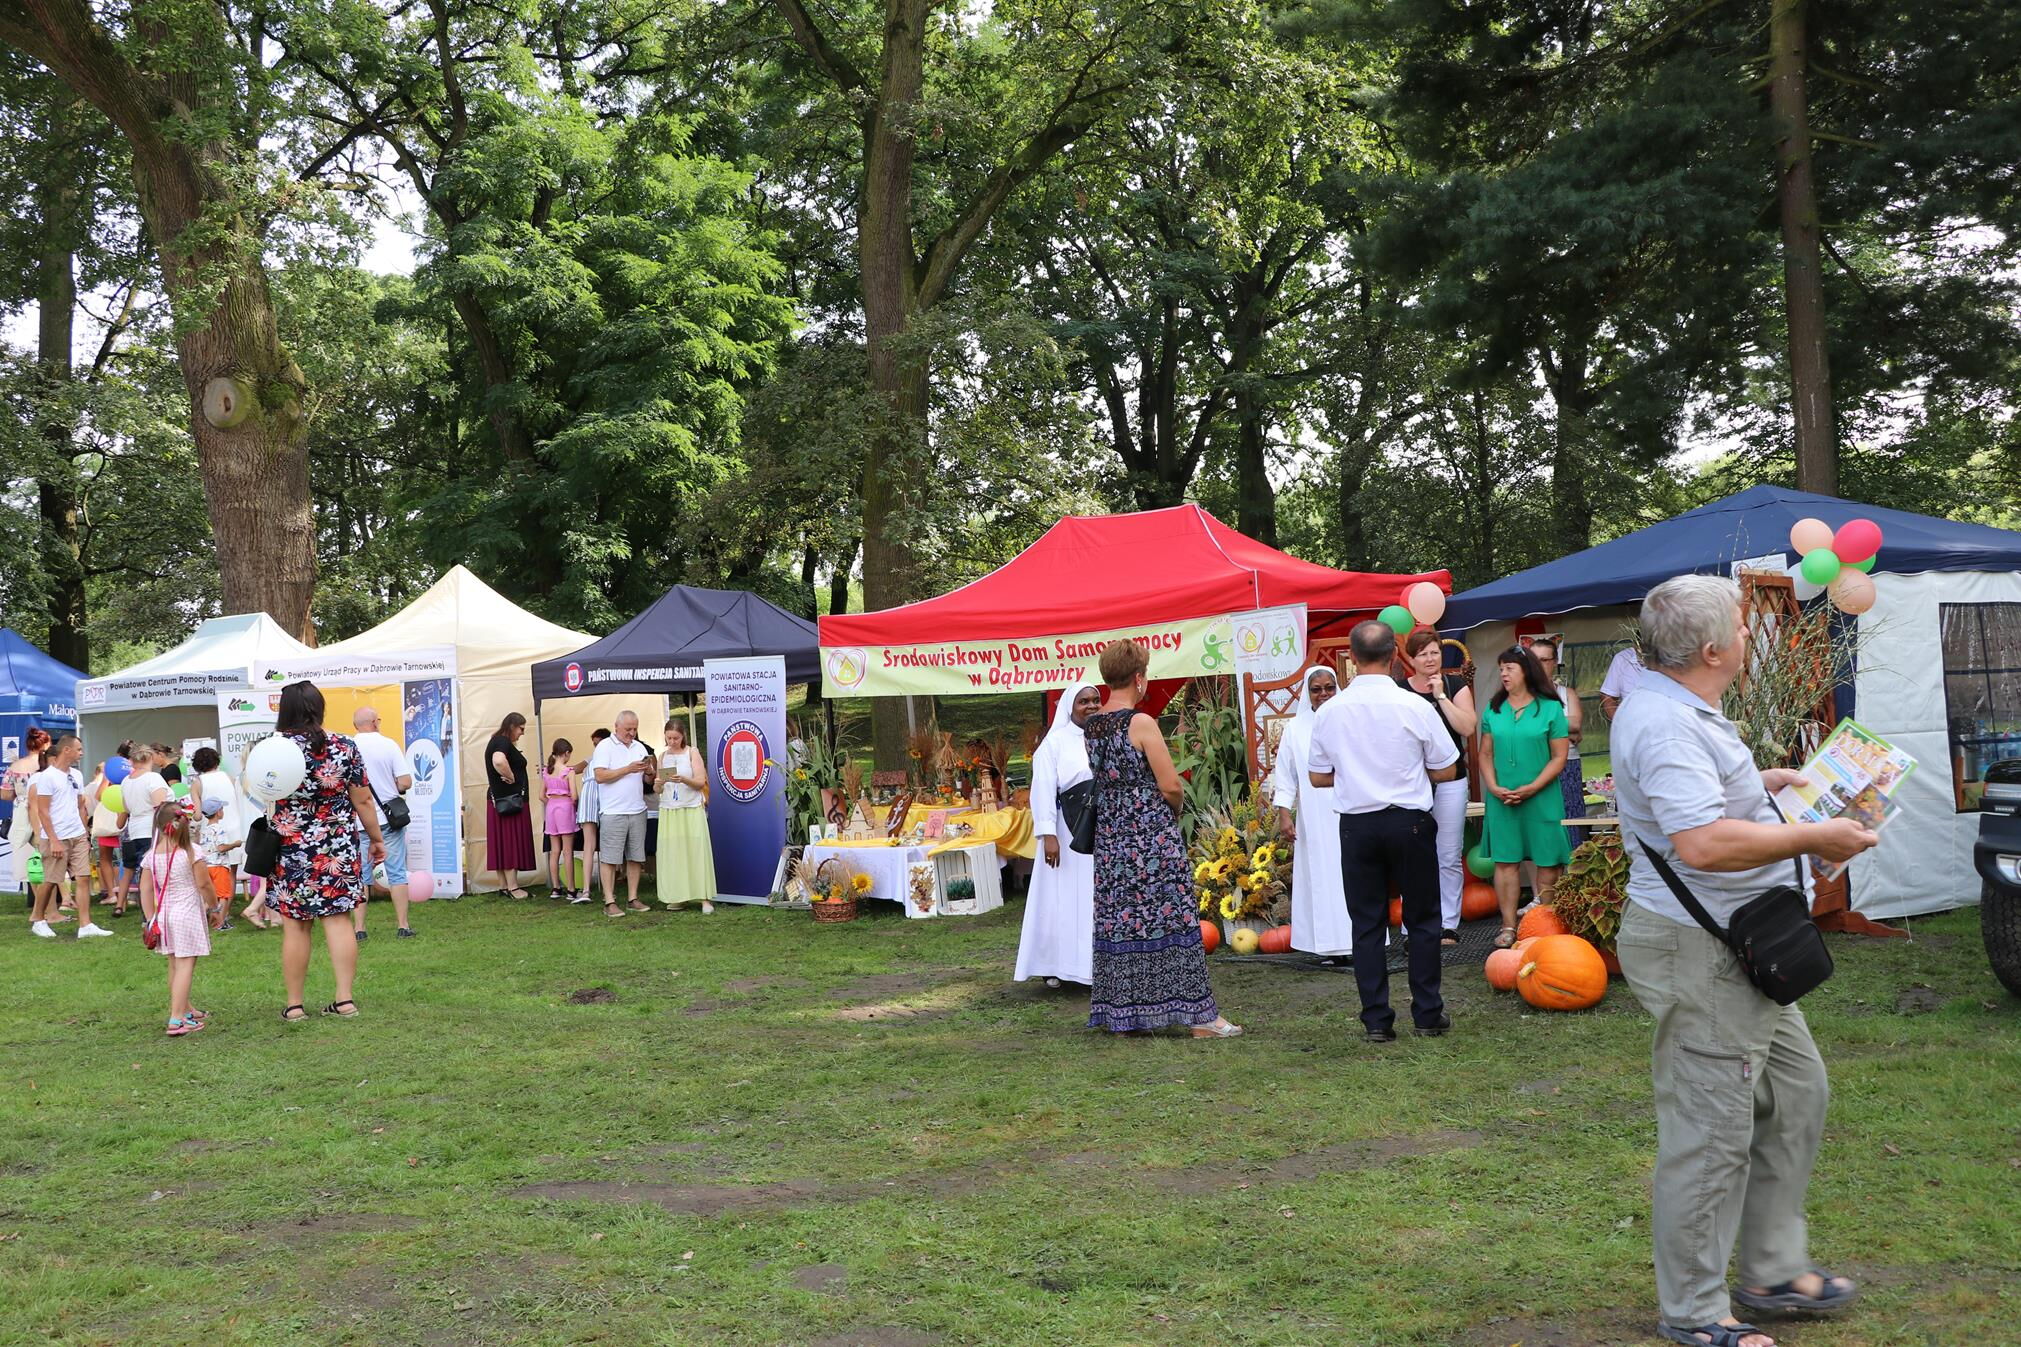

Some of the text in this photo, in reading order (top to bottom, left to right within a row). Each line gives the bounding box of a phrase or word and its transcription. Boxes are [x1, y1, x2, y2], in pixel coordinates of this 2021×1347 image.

[1007, 643, 1049, 662] Dom
[1055, 632, 1182, 660] Samomocy
[288, 670, 321, 679] Powiatowy
[323, 667, 342, 677] Urząd
[343, 666, 361, 676] Pracy
[370, 664, 402, 673] Dąbrowie
[403, 661, 445, 671] Tarnowskiej
[588, 668, 633, 682] PAŃSTWOWA
[634, 667, 673, 680] INSPEKCJA
[673, 666, 705, 679] SANITAR
[711, 671, 777, 681] POWIATOWA STACJA
[968, 663, 1086, 690] w Dąbrowicy
[110, 674, 239, 691] Powiatowe Centrum Pomocy Rodzinie
[724, 683, 763, 692] SANITARNO-
[139, 689, 171, 699] Dąbrowie
[173, 686, 216, 696] Tarnowskiej
[711, 694, 777, 704] EPIDEMIOLOGICZNA
